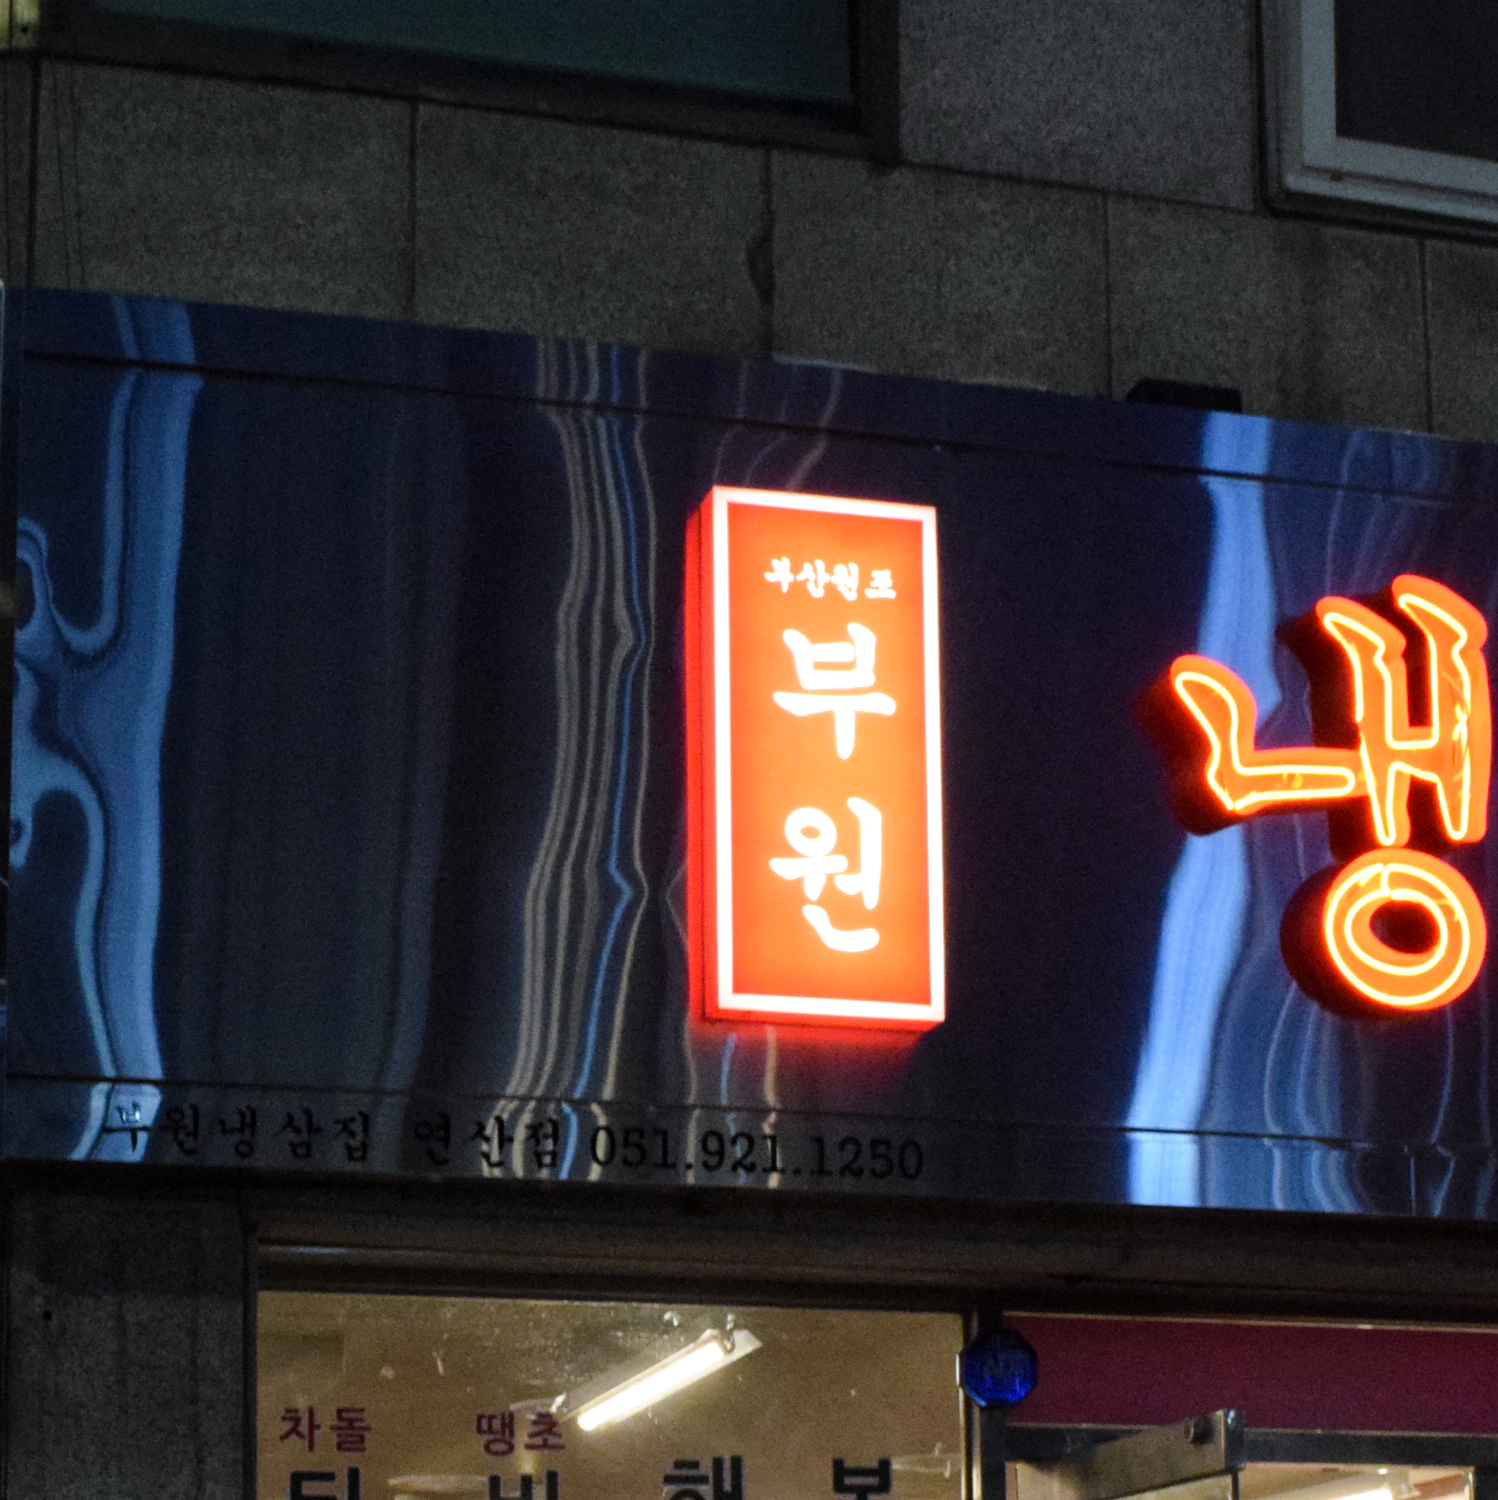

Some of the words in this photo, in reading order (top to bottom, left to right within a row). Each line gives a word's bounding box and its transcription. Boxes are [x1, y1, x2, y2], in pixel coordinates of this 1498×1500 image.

[763, 557, 897, 602] 부산원조
[769, 621, 899, 954] 부원
[102, 1102, 376, 1161] 부원냉삼집
[412, 1113, 565, 1171] 연산점
[589, 1124, 924, 1181] 051.921.1250
[277, 1406, 374, 1456] 차돌
[473, 1409, 567, 1456] 땡초
